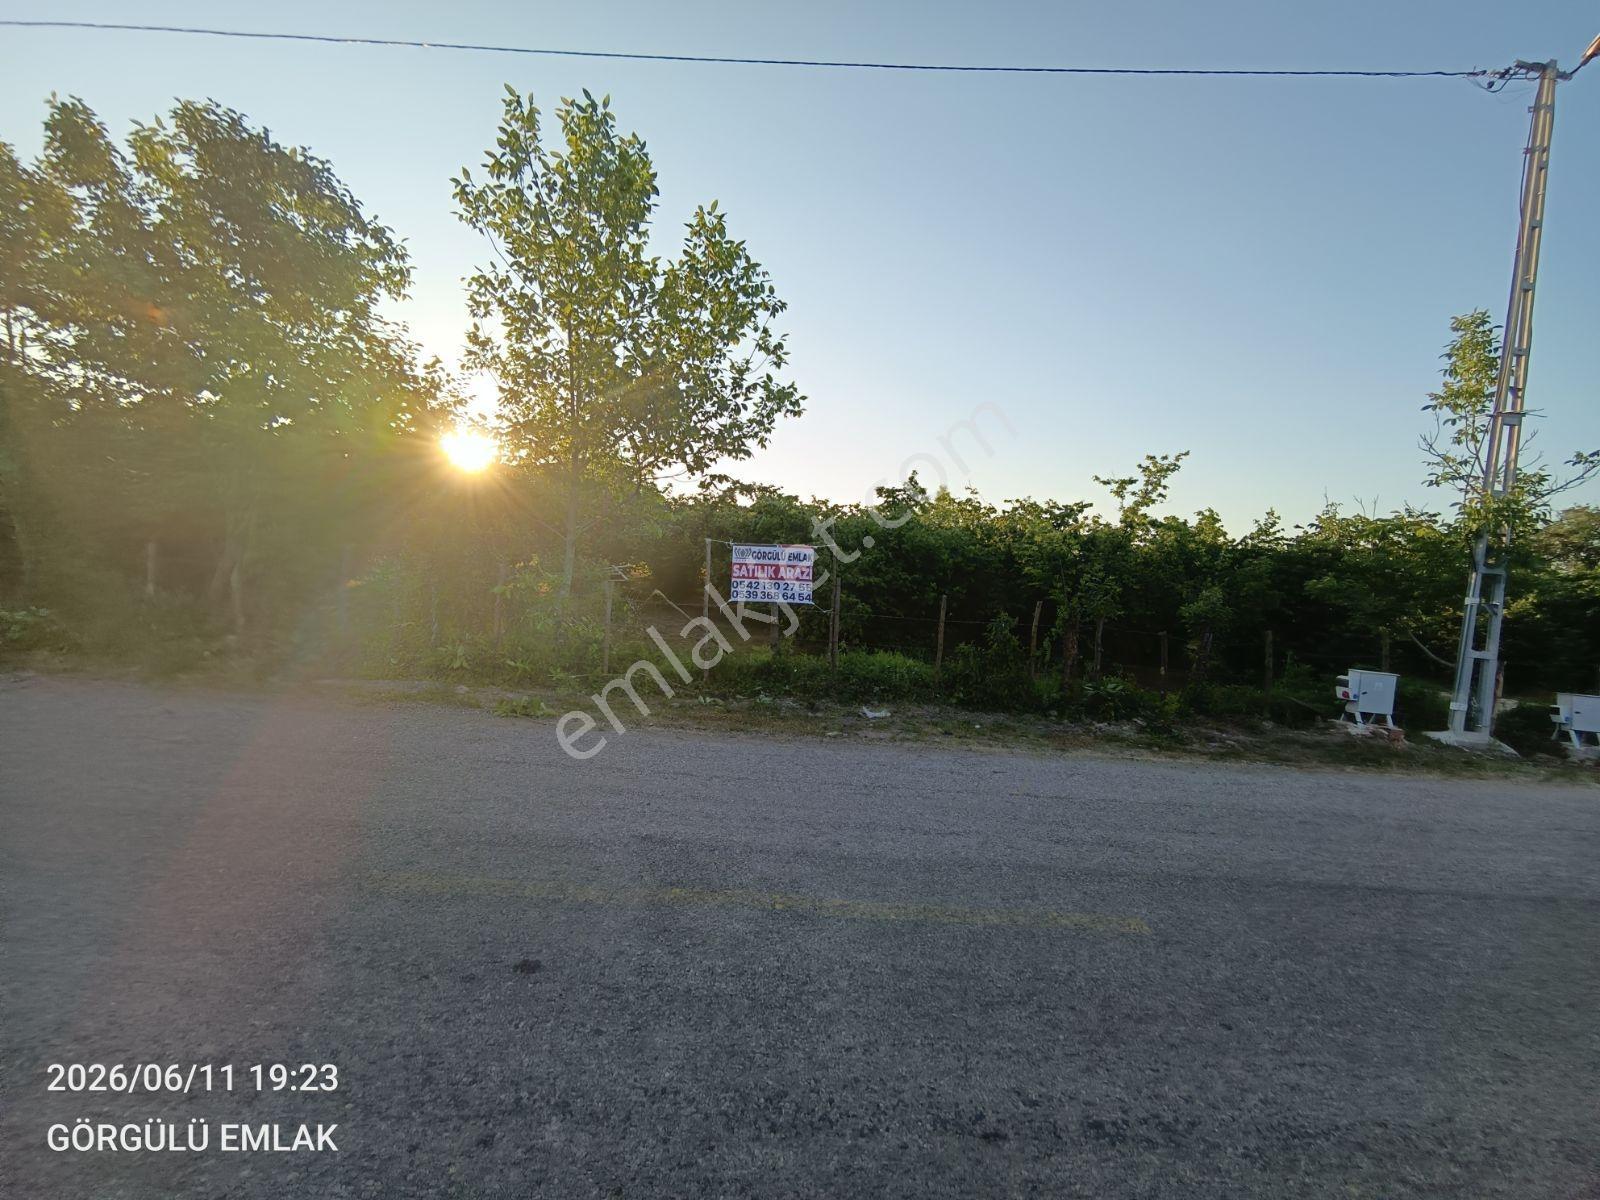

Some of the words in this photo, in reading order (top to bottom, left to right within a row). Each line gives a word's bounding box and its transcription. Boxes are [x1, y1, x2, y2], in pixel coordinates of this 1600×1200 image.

[752, 549, 786, 561] GÖRGÜLÜ
[788, 552, 812, 562] EMLAK
[732, 565, 776, 578] SATILIK
[732, 580, 760, 590] 0542
[763, 581, 780, 590] 130
[783, 582, 795, 591] 27
[732, 590, 758, 599] 0539
[760, 591, 780, 600] 368
[782, 592, 796, 601] 64
[798, 592, 812, 601] 54
